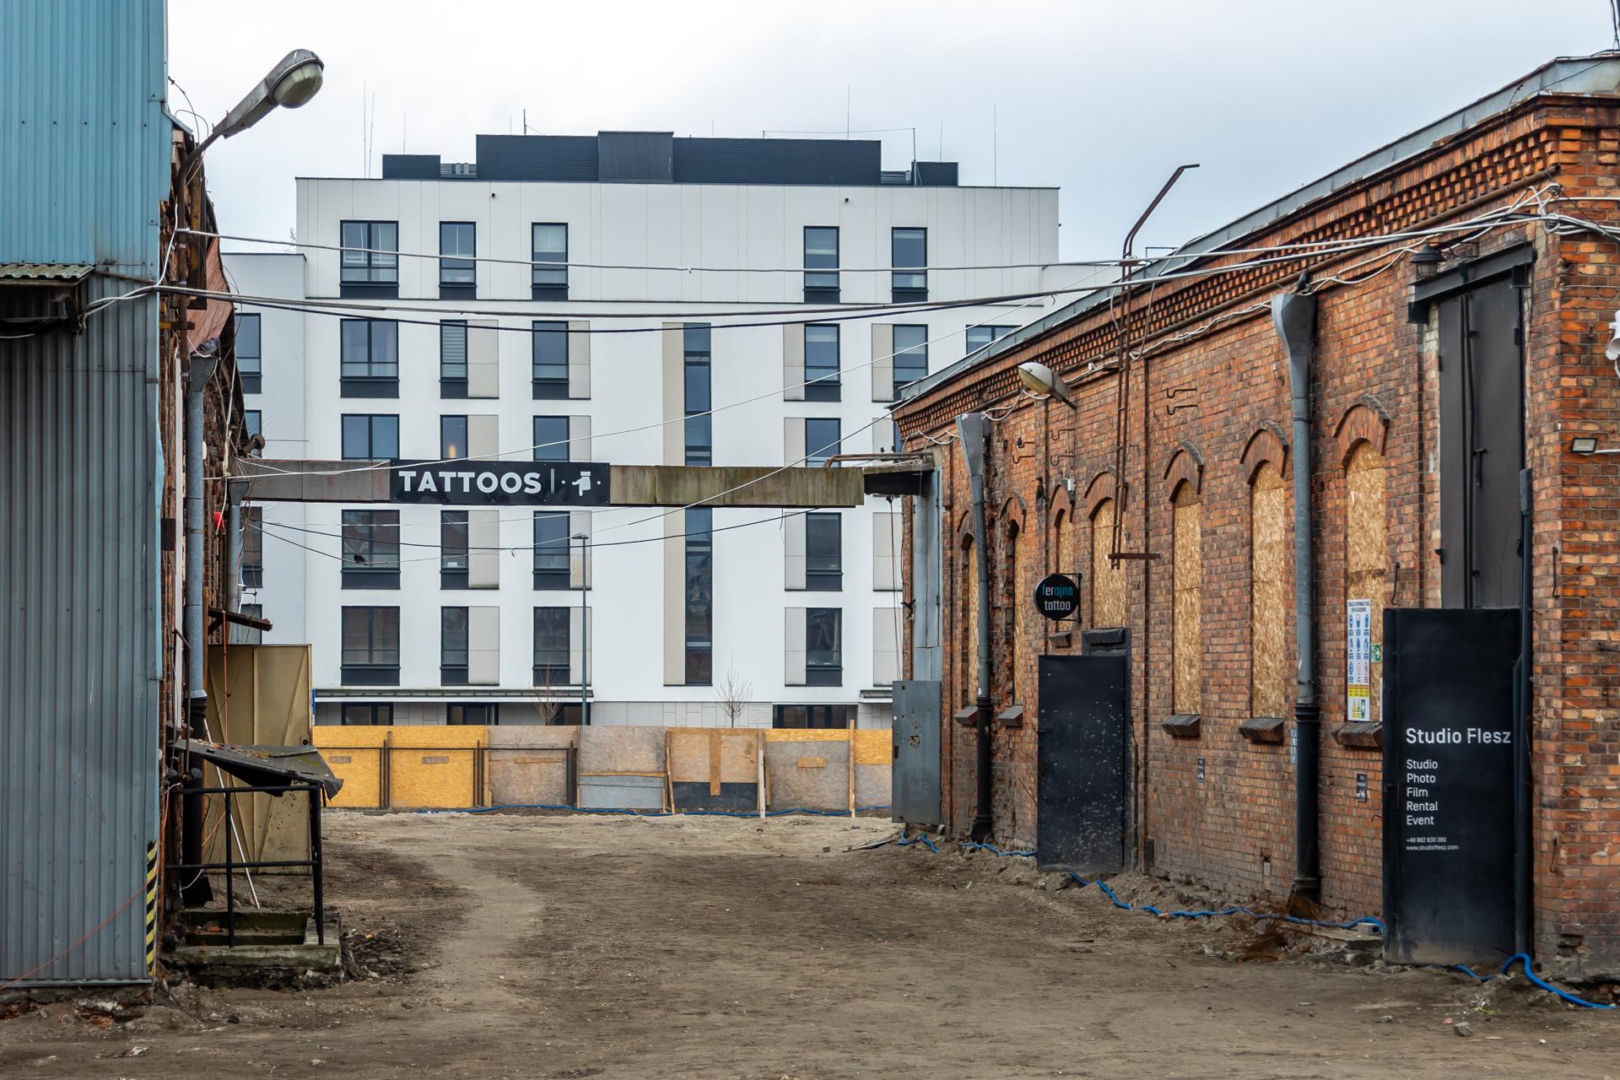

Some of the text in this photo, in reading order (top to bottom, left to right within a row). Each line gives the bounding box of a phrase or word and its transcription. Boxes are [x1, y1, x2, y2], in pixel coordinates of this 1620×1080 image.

[398, 470, 542, 494] TATTOOS
[1406, 727, 1512, 744] Studio Flesz
[1406, 759, 1438, 770] Studio
[1406, 773, 1436, 783] Photo
[1406, 787, 1429, 797] Film
[1406, 801, 1439, 811] Rental
[1406, 815, 1435, 826] Event
